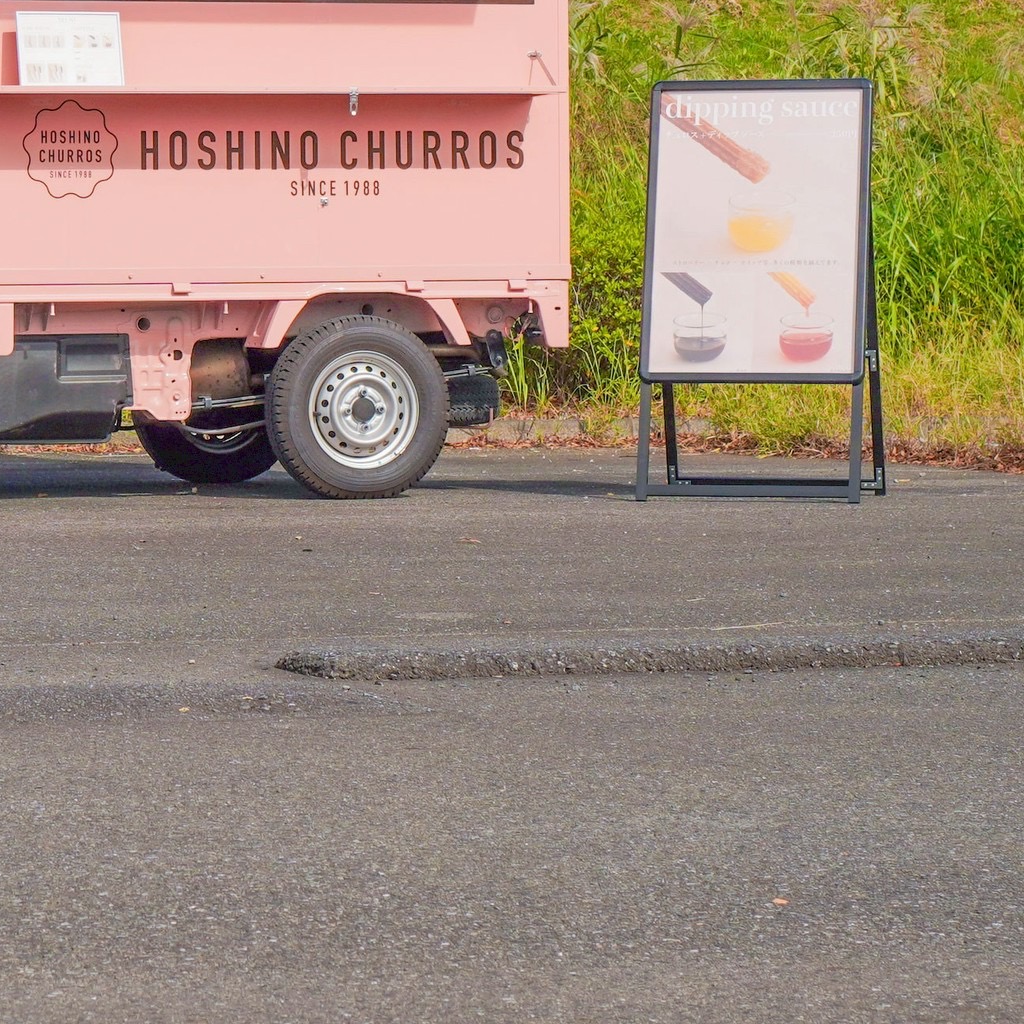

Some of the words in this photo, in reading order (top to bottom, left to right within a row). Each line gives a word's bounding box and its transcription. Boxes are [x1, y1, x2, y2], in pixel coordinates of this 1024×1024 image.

[665, 94, 775, 126] dipping
[781, 99, 857, 118] sauce
[40, 130, 101, 144] HOSHINO
[39, 149, 102, 163] CHURROS
[140, 130, 319, 170] HOSHINO
[339, 129, 525, 170] CHURROS
[49, 170, 72, 179] SINCE
[74, 170, 92, 179] 1988
[290, 180, 337, 196] SINCE
[344, 180, 381, 196] 1988
